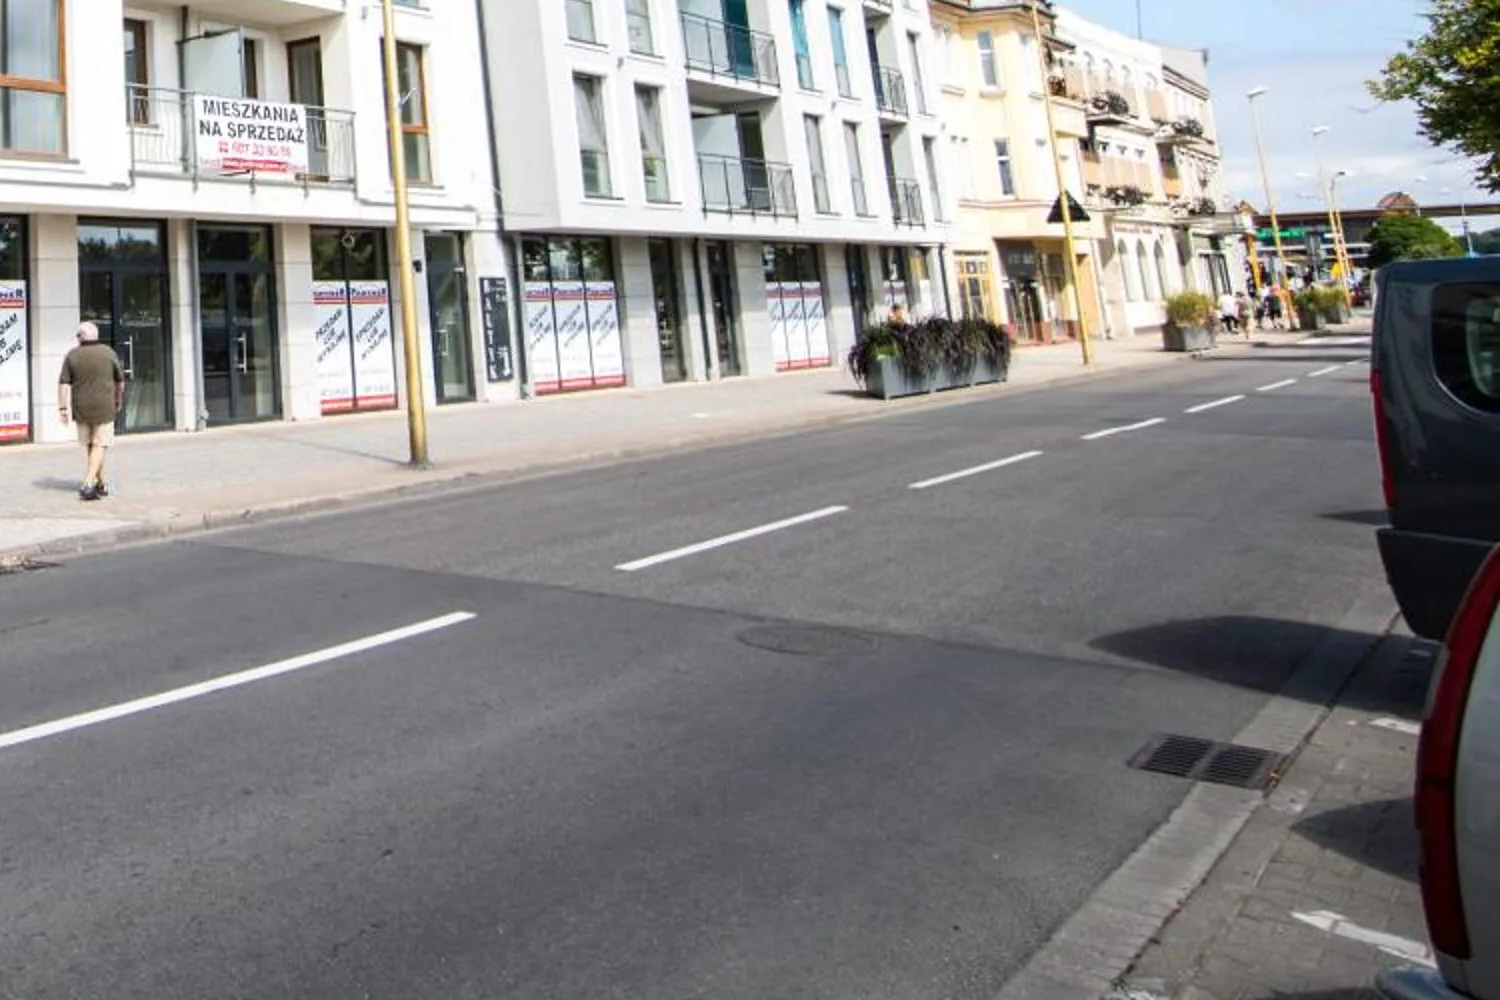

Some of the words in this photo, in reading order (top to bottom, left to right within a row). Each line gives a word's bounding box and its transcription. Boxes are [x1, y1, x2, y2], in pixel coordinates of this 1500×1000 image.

[202, 99, 299, 123] MIESZKANIA
[199, 119, 223, 137] NA
[227, 121, 305, 144] SPRZEDAŻ
